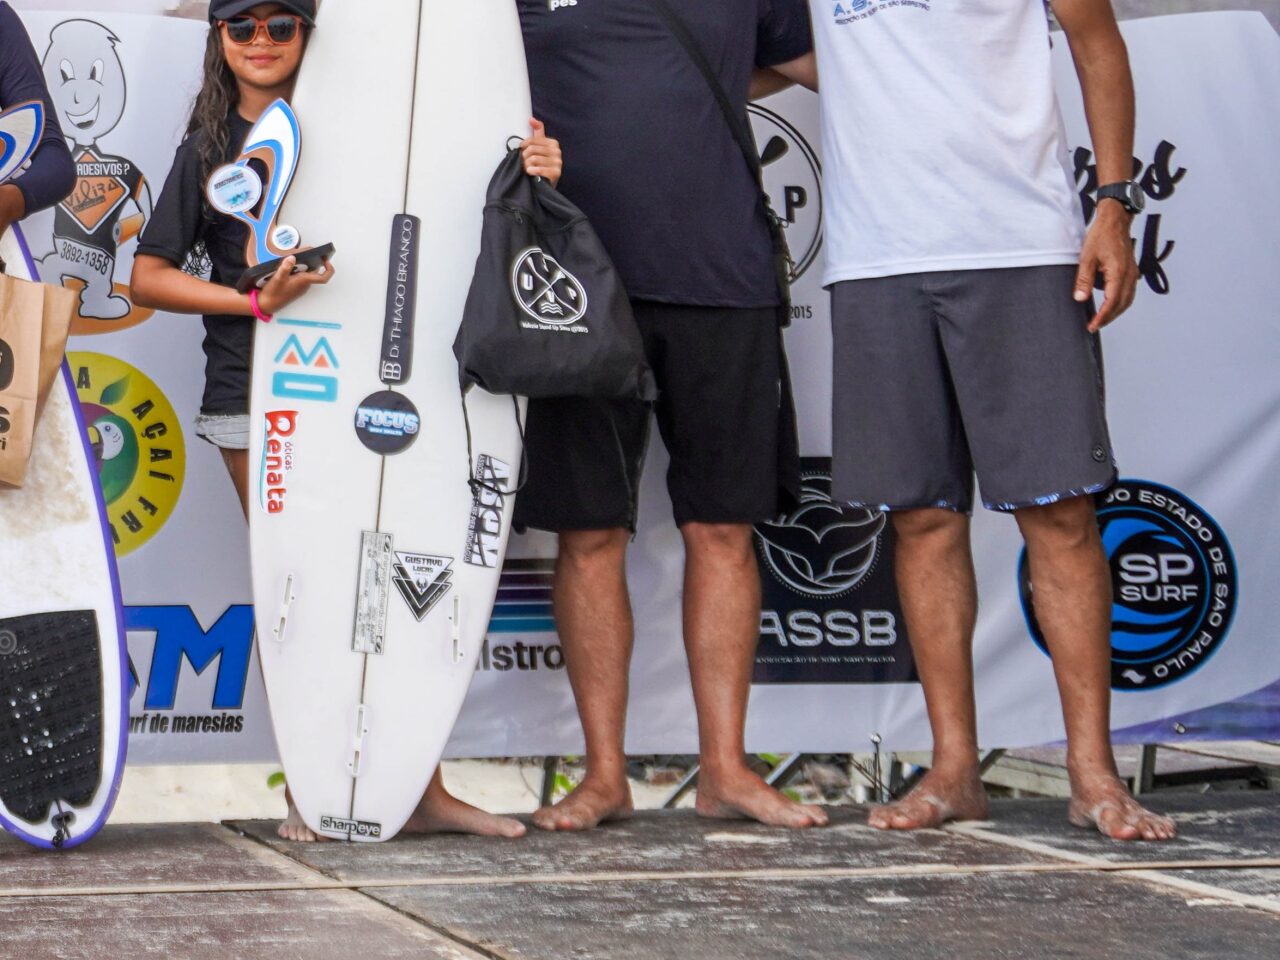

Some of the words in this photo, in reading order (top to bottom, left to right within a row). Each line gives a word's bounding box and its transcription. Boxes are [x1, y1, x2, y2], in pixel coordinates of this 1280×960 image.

[60, 241, 110, 276] 3892-1358
[397, 219, 413, 283] BRANCO
[390, 284, 406, 342] THIAGO
[356, 408, 419, 434] FOCUS
[265, 410, 299, 514] Renata
[284, 442, 293, 471] óticas
[1139, 489, 1213, 542] ESTADO
[405, 556, 443, 567] GUSTAVO
[1120, 553, 1195, 584] SP
[1207, 547, 1227, 576] DE
[1120, 584, 1199, 602] SURF
[760, 610, 897, 647] ASSB
[1153, 631, 1213, 679] PAULO
[149, 712, 169, 733] de
[172, 712, 244, 733] maresias
[322, 816, 380, 836] sharpeye
